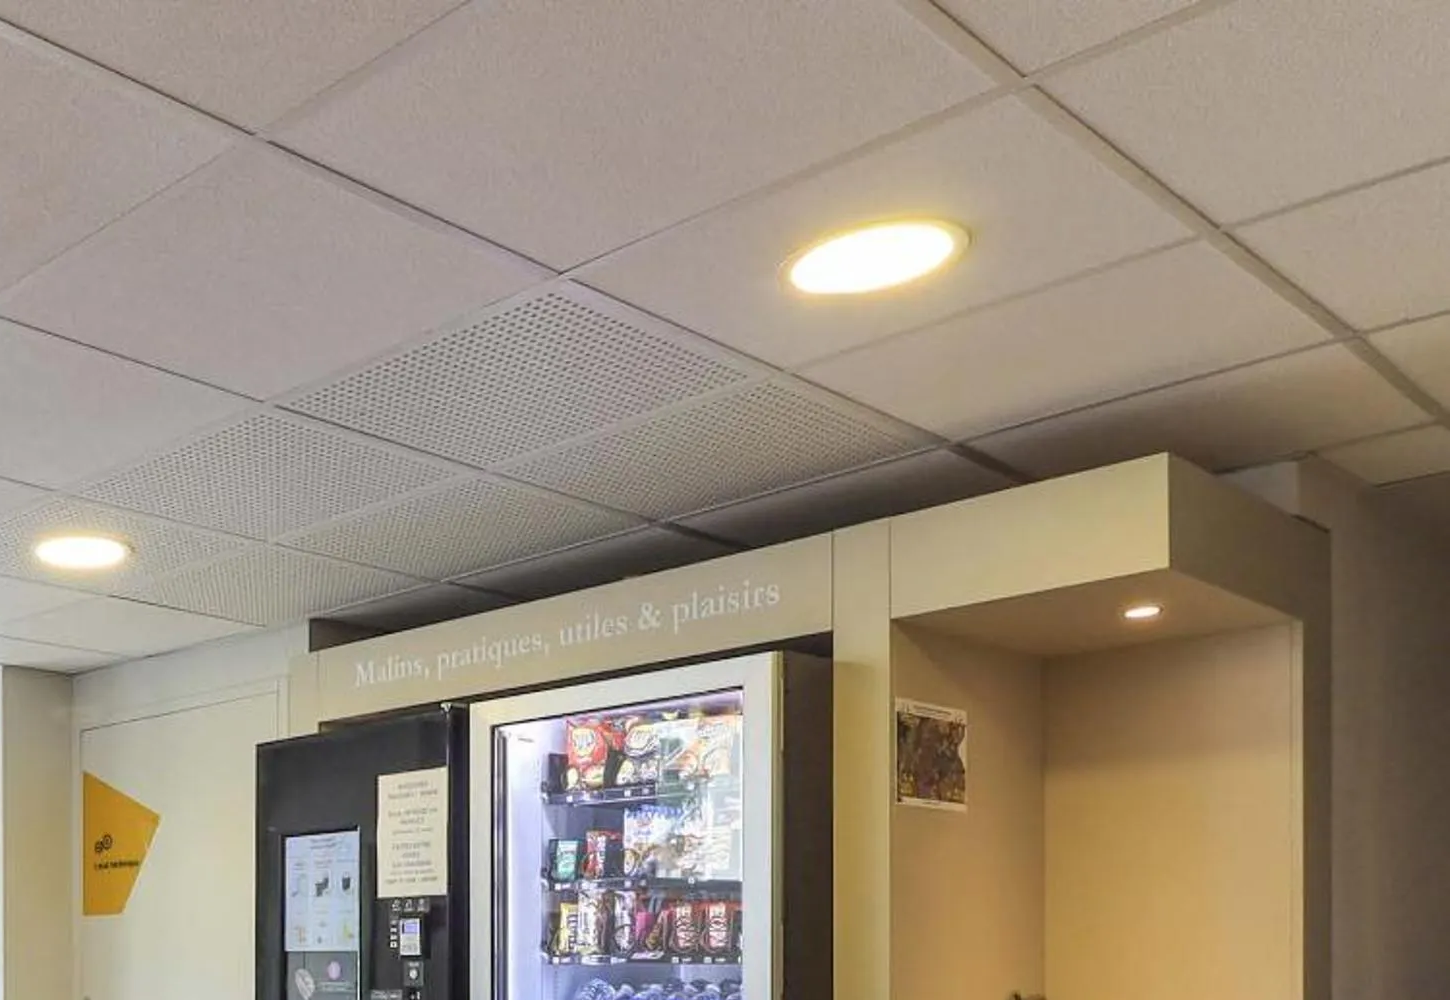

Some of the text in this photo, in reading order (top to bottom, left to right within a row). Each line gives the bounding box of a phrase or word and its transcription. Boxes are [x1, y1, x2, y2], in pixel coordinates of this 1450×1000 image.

[353, 580, 780, 688] Malins, pratiques, utiles & plaisirs
